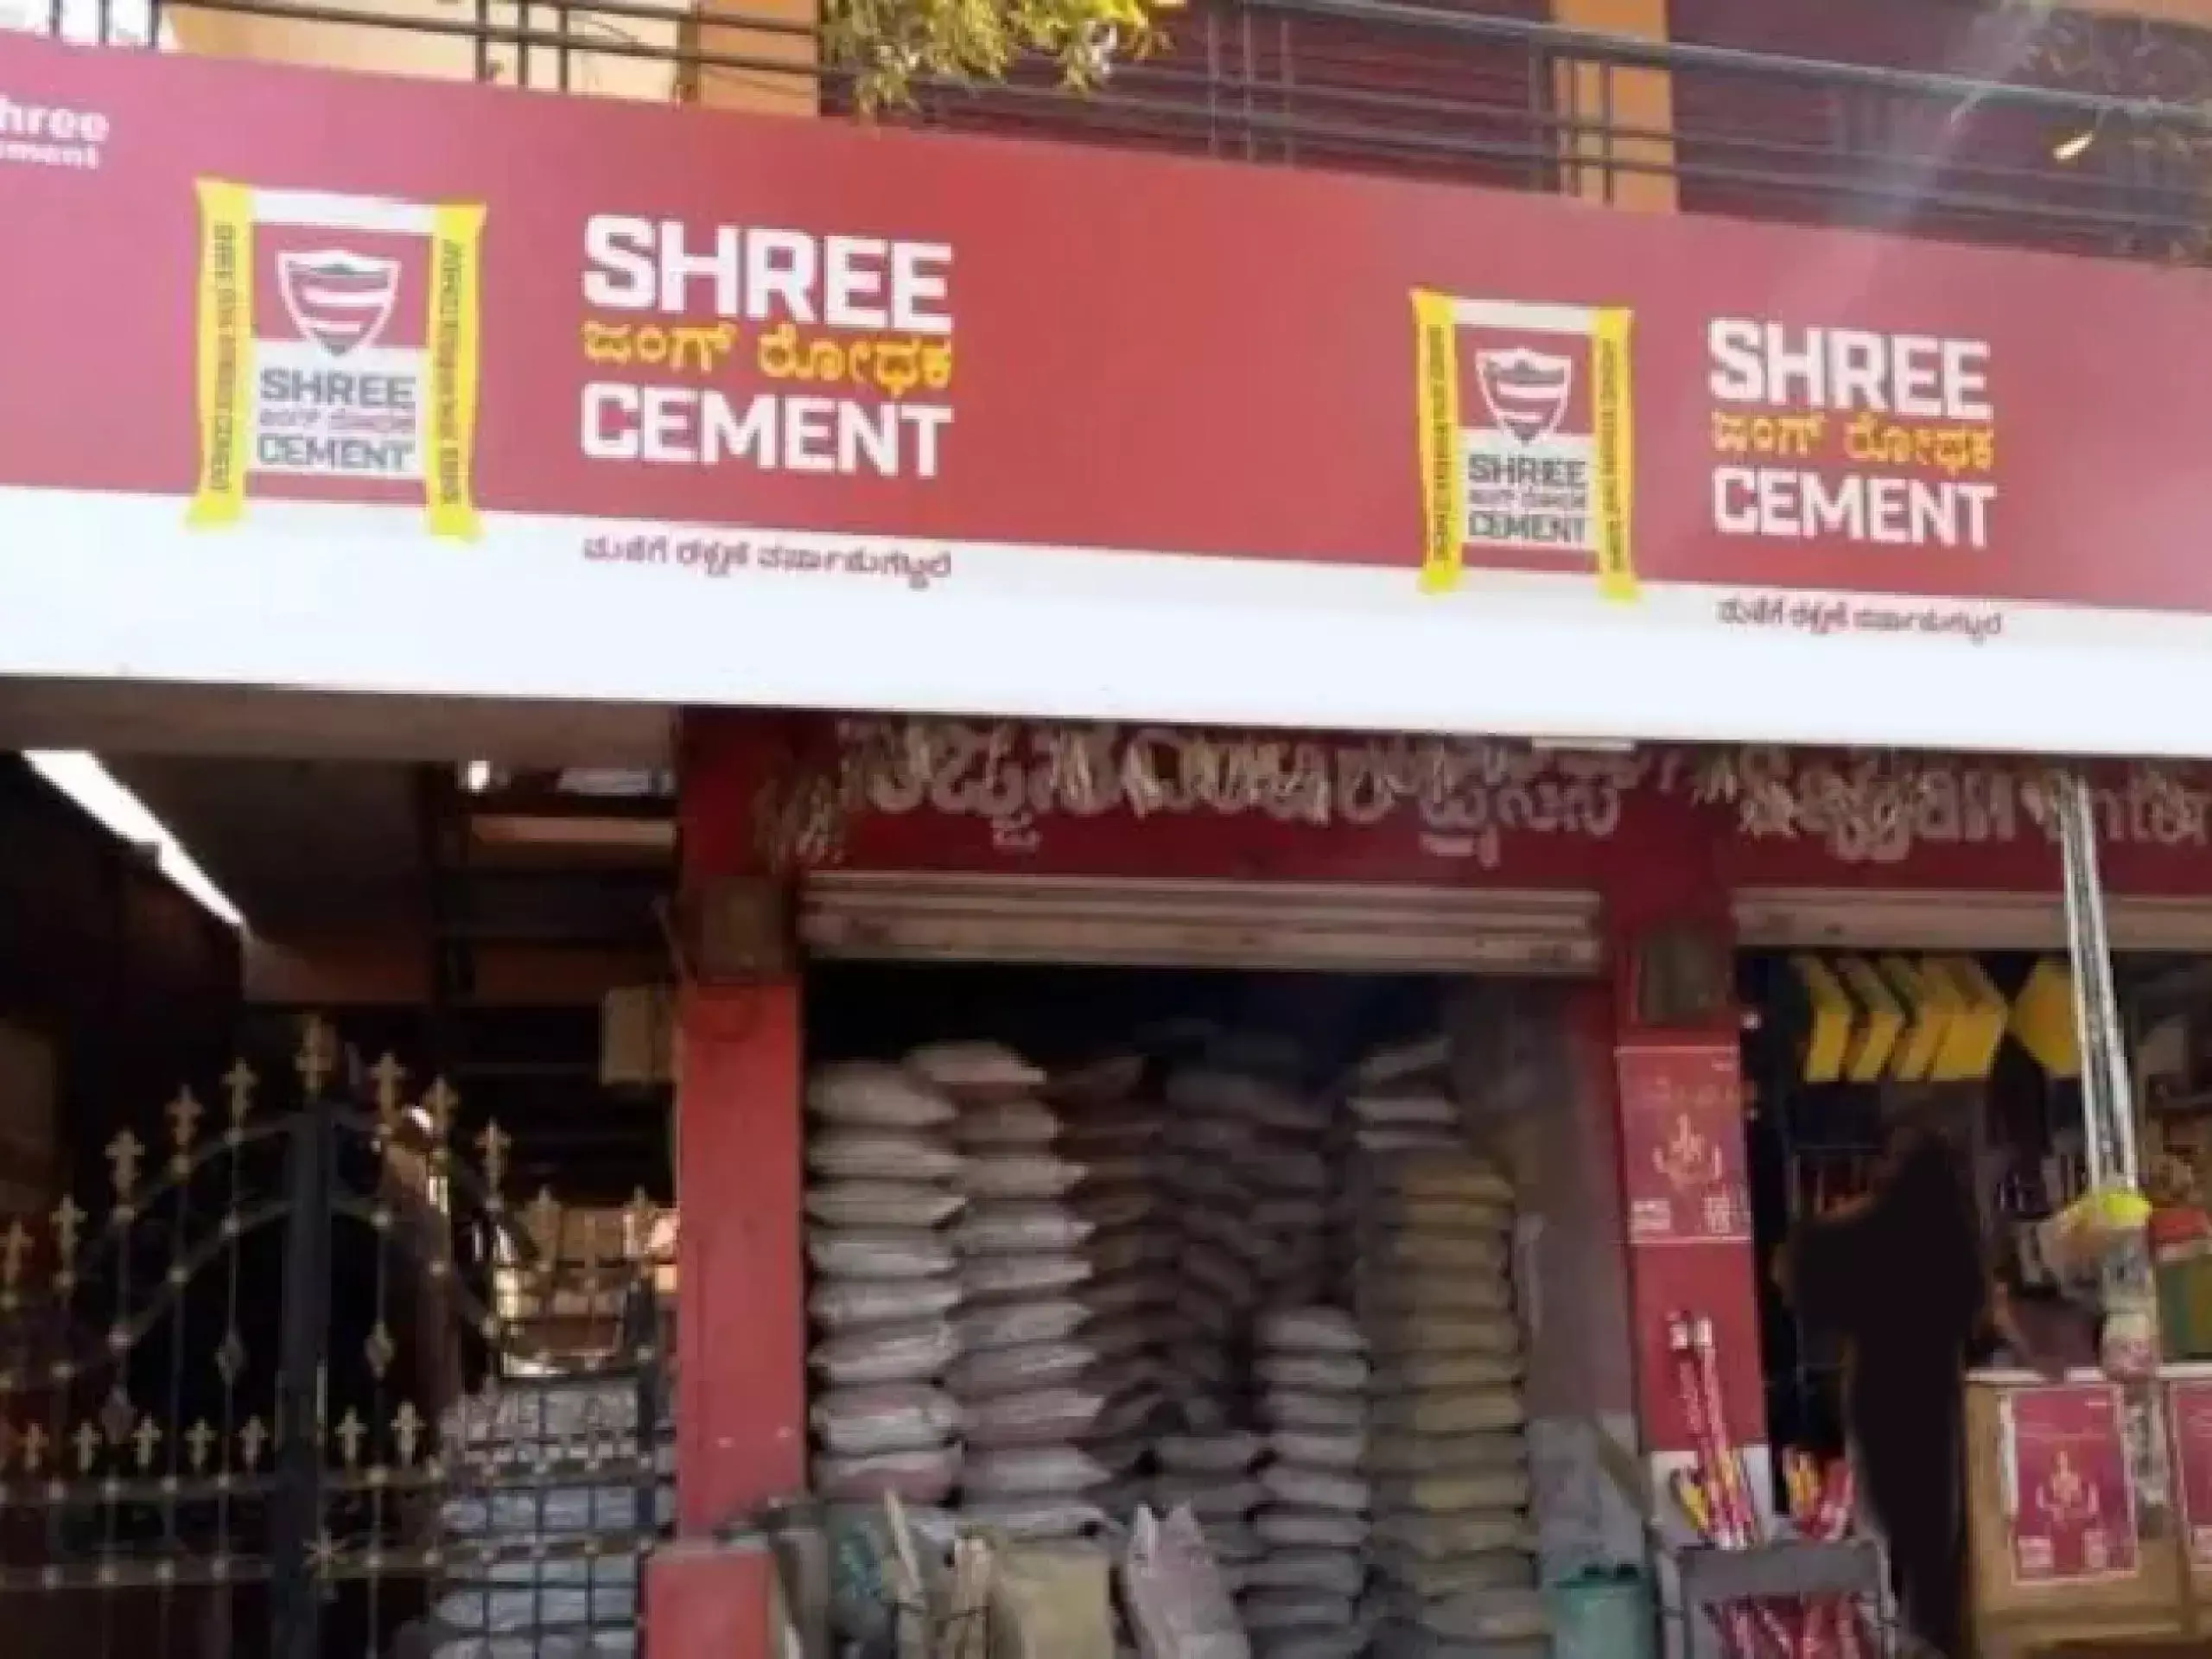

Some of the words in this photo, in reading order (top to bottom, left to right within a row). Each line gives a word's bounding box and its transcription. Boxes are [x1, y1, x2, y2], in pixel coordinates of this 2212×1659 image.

[582, 213, 954, 336] SHREE
[259, 368, 416, 409] SHREE
[1708, 318, 1993, 421] SHREE
[257, 432, 415, 472] CEMENT
[580, 381, 955, 478] CEMENT
[1712, 465, 1998, 550] CEMENT
